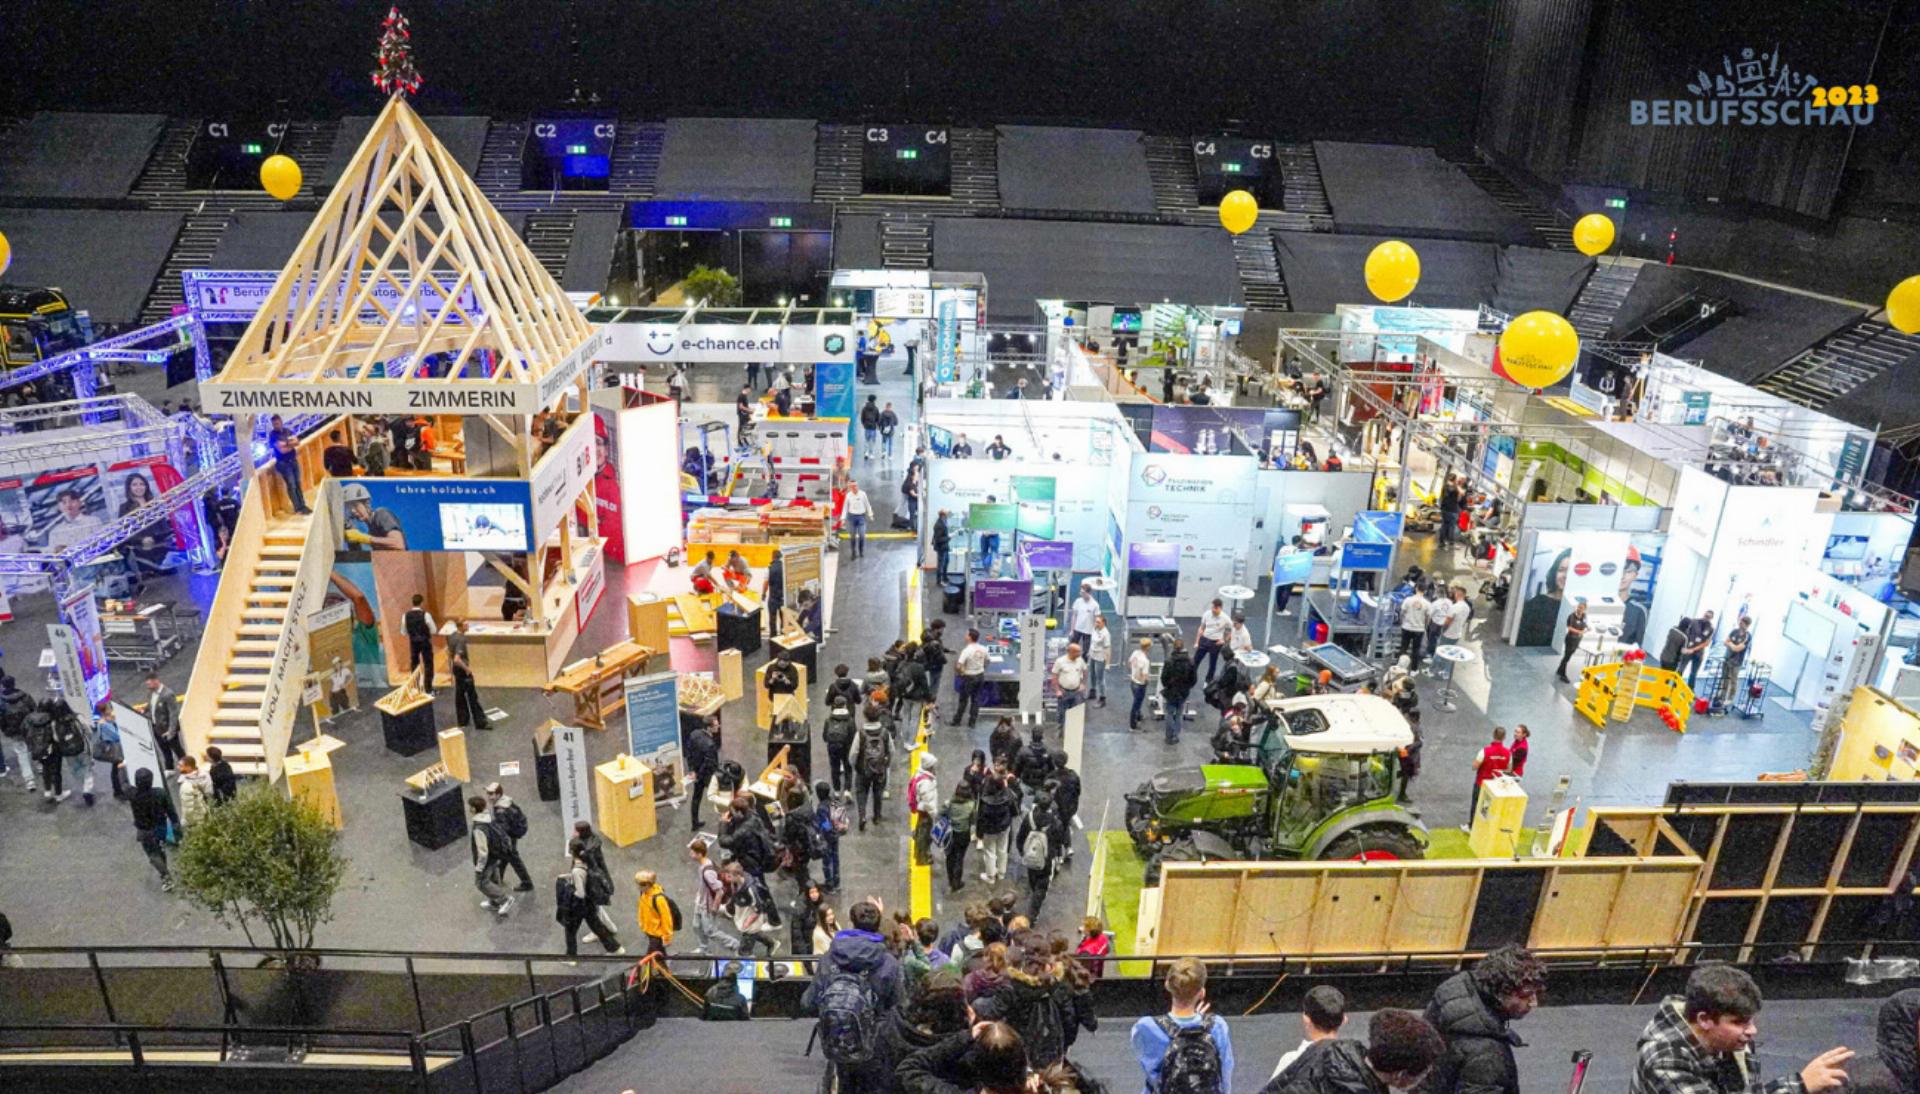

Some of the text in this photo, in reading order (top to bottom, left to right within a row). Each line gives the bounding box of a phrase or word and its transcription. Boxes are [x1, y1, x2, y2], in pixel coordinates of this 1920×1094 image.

[208, 122, 229, 137] C1
[534, 123, 557, 138] C2
[594, 124, 615, 138] C3
[866, 128, 889, 142] C3
[925, 130, 948, 144] C4
[1195, 141, 1216, 156] C4
[1250, 144, 1272, 158] C5
[681, 337, 780, 351] e-chance.ch
[220, 390, 516, 408] ZIMMERMANN ZIMMERIN
[395, 485, 497, 495] lehre-holzbau.ch
[1028, 618, 1040, 629] 36
[266, 581, 308, 725] HOLZ MACHT STOLZ
[563, 732, 574, 743] 41
